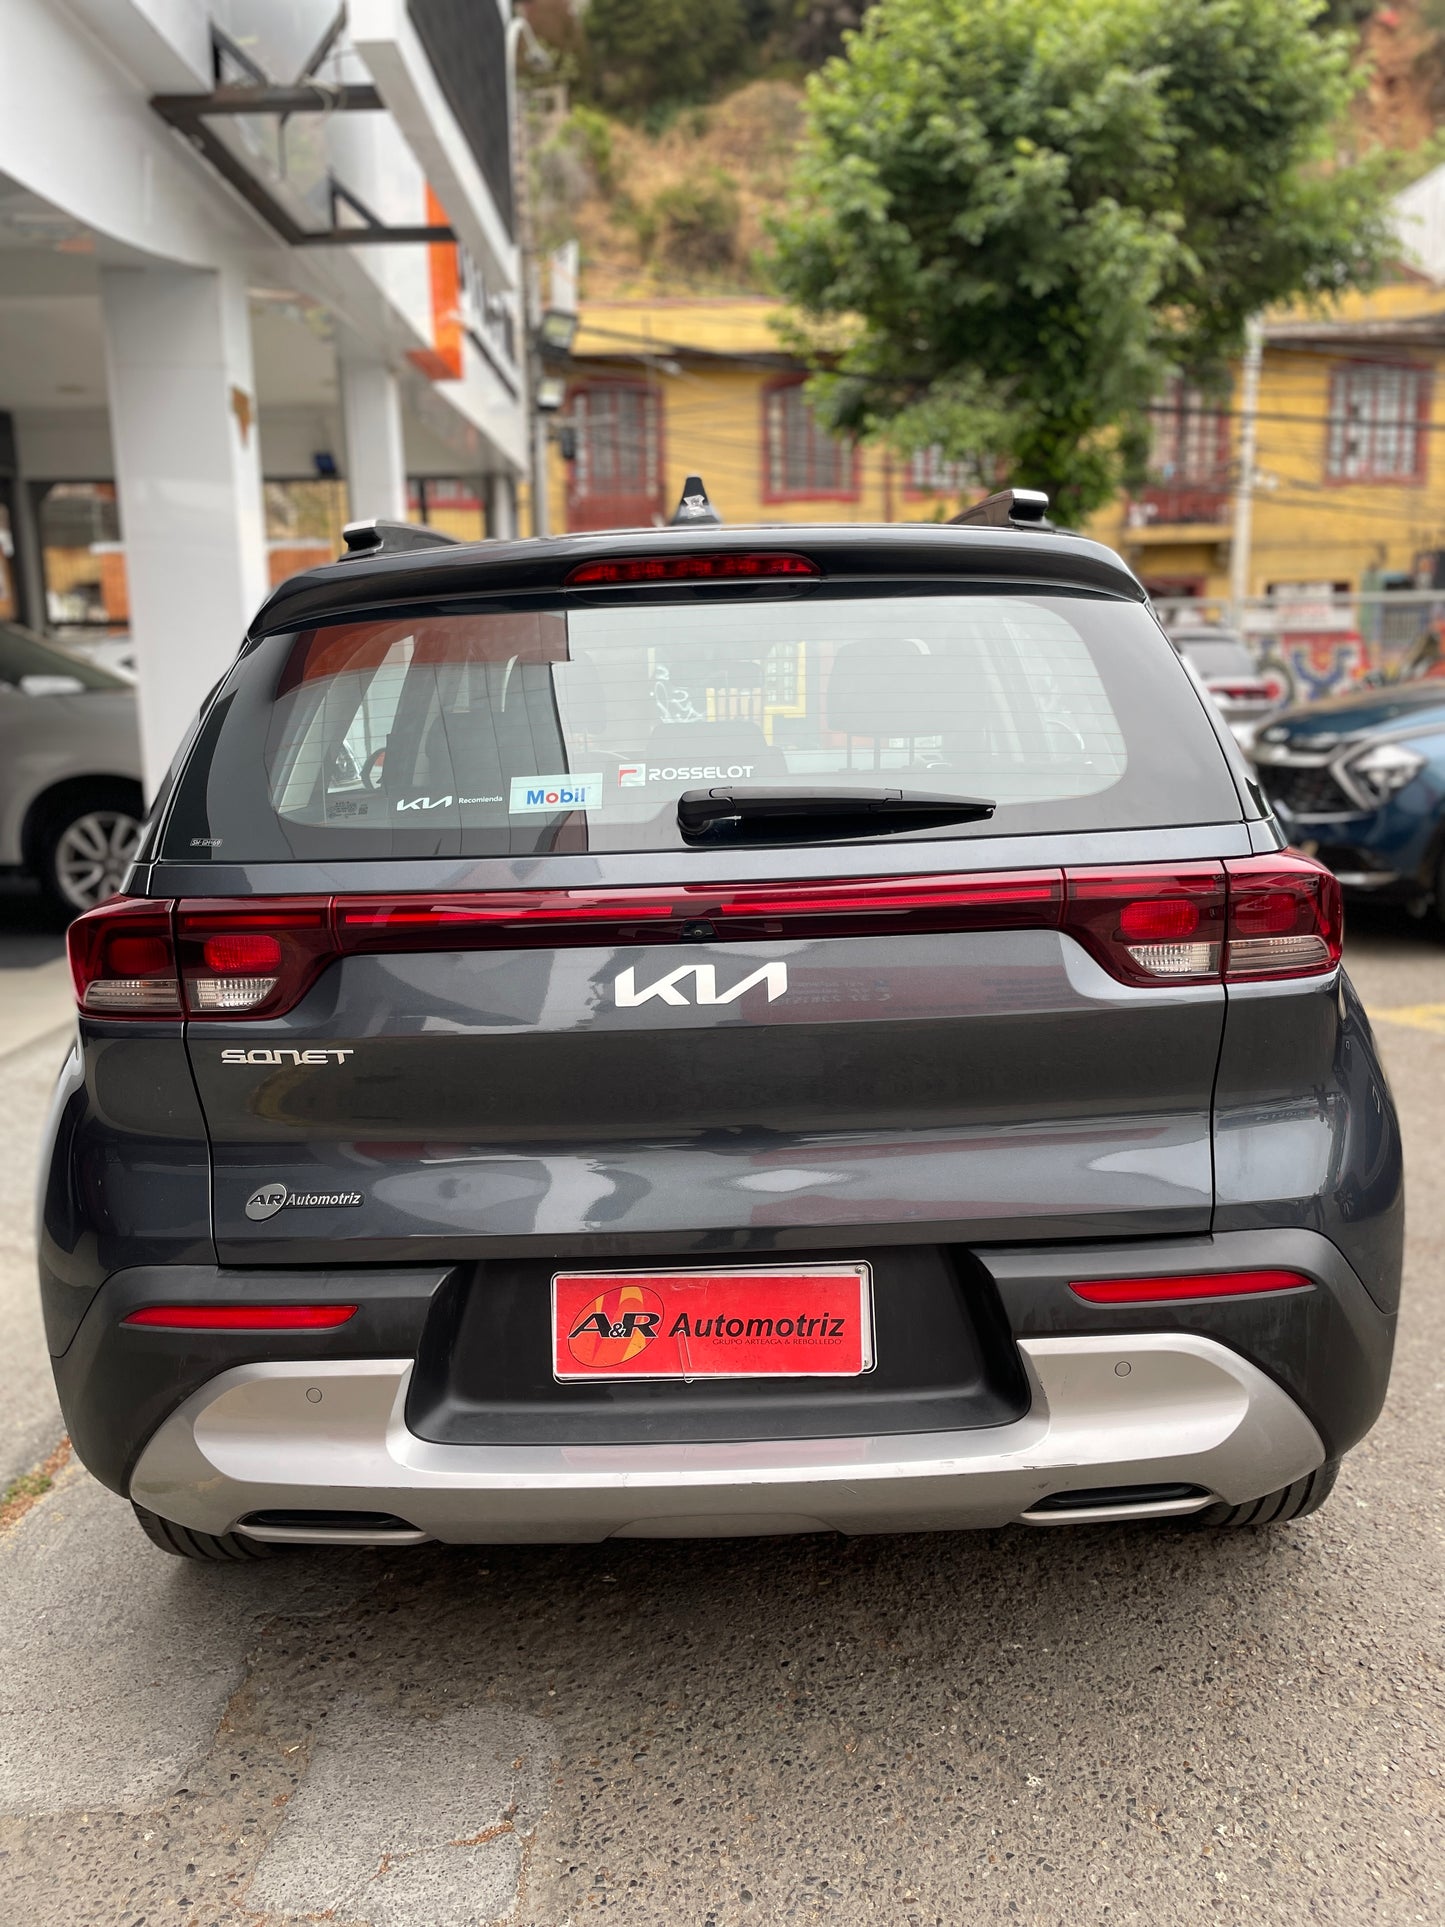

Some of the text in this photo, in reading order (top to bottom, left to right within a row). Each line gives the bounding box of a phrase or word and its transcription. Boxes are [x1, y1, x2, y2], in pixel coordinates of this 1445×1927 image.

[649, 765, 754, 781] ROSSELOT
[396, 795, 503, 812] KIA Recomienda
[526, 787, 586, 806] Mobil
[614, 961, 788, 1008] KIA
[221, 1049, 354, 1066] SONET
[248, 1191, 362, 1207] AR Automotriz
[568, 1311, 846, 1339] A&R Automotriz
